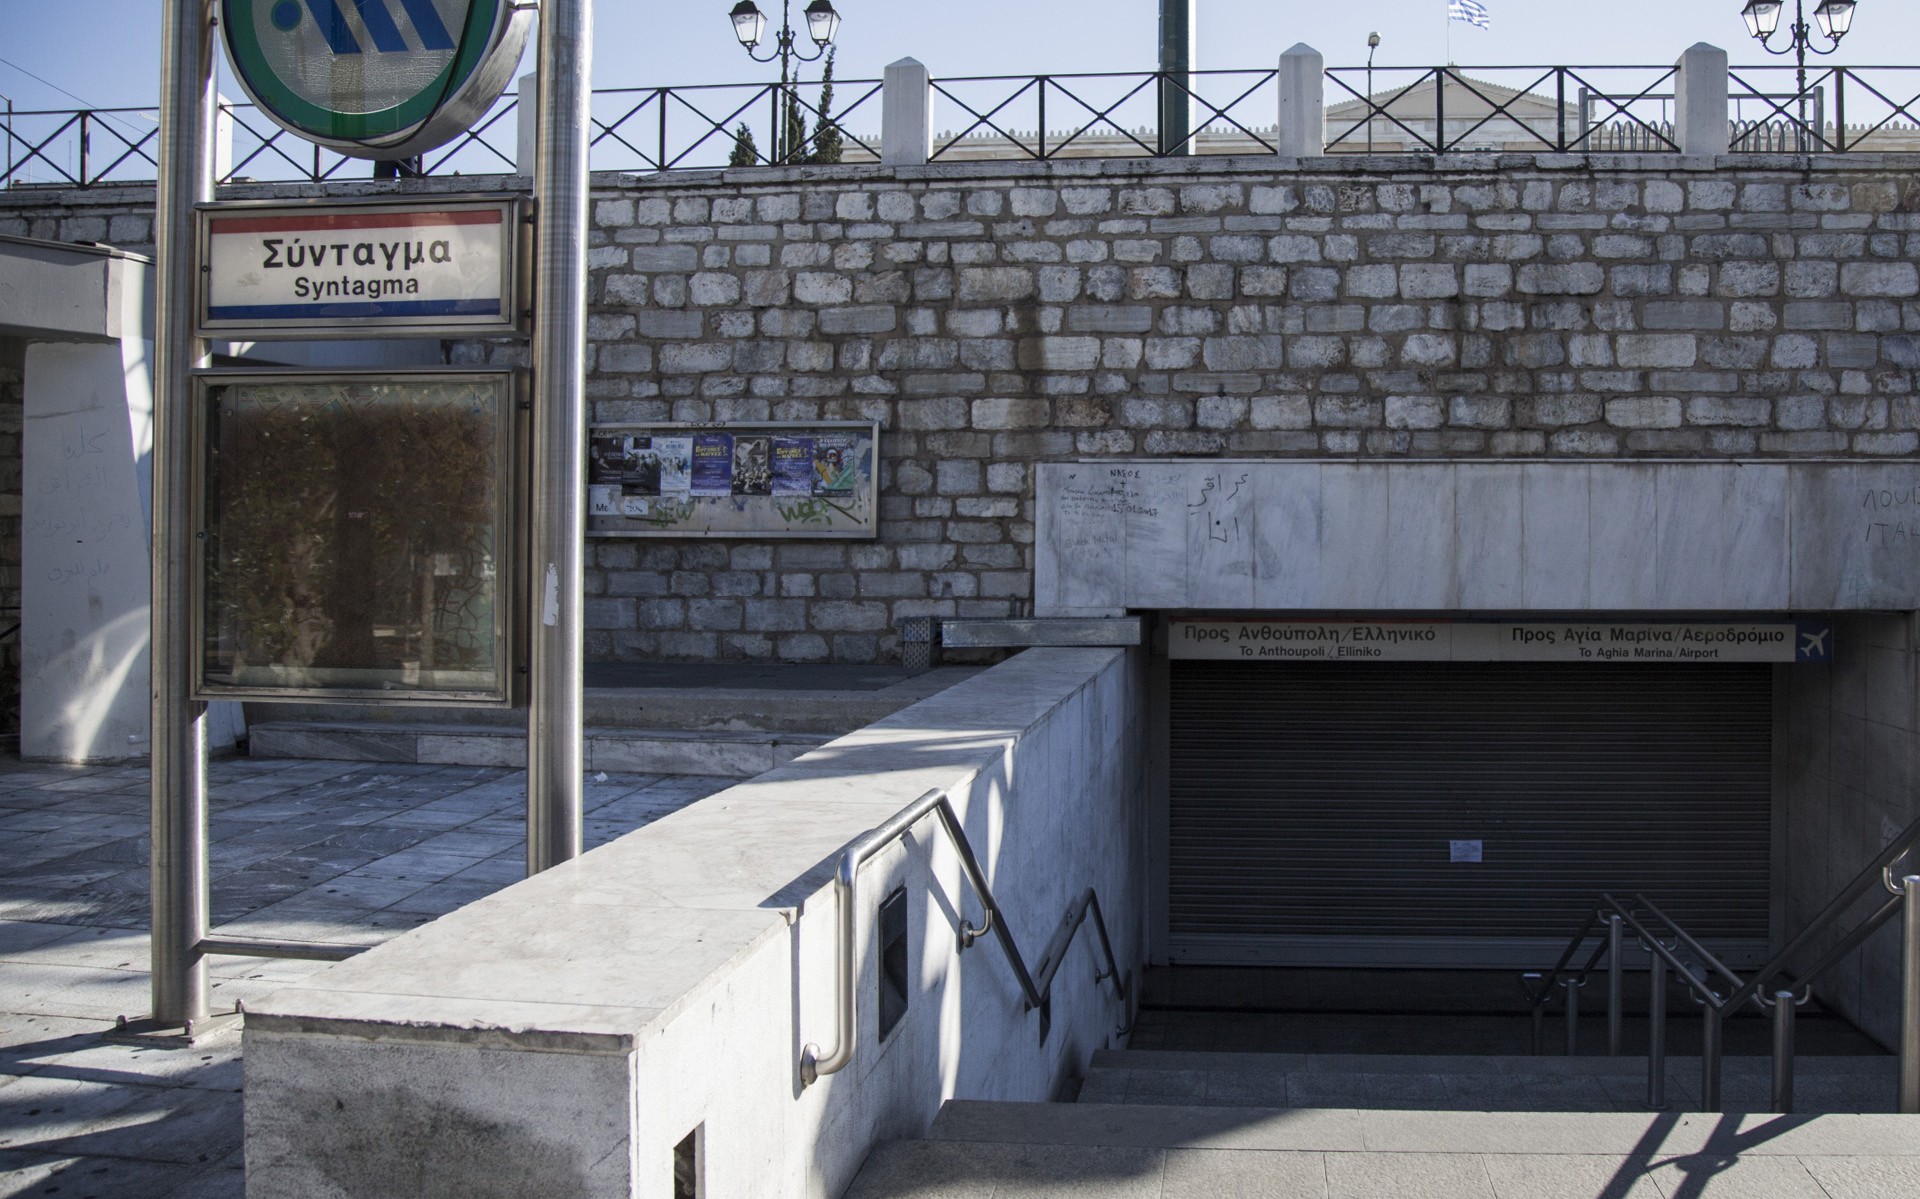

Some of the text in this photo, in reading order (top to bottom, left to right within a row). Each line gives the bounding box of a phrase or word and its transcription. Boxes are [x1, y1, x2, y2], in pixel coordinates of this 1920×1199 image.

[262, 238, 452, 271] Σύνταγμα
[294, 276, 419, 300] Syntagma
[1185, 625, 1229, 642] Προς
[1512, 627, 1555, 644] Προς
[1564, 627, 1602, 644] Αγία
[1239, 646, 1253, 656] To
[1579, 647, 1592, 657] To
[1597, 647, 1629, 659] Aghia
